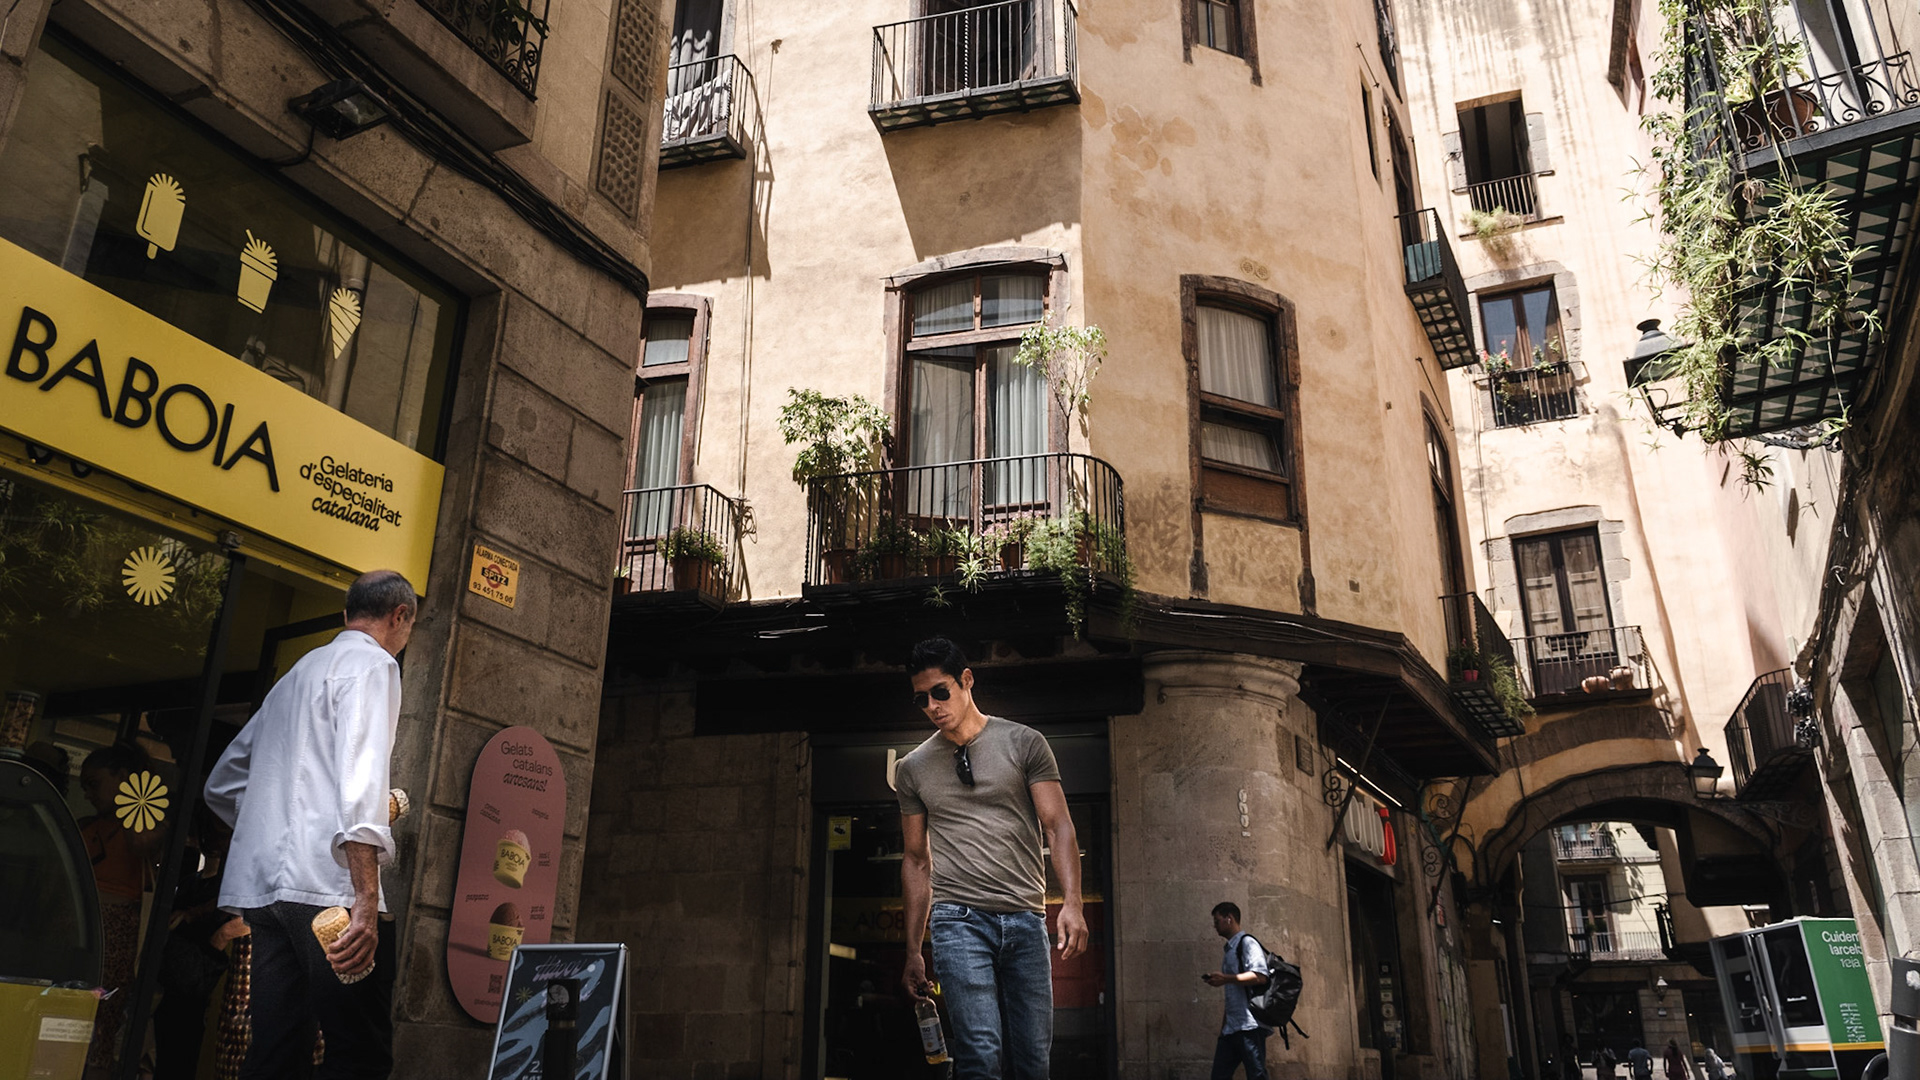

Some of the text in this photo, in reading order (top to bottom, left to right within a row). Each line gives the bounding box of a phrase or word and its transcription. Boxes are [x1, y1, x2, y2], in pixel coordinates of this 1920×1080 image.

[5, 306, 280, 493] BABOIA
[320, 455, 393, 492] Gelateria
[300, 462, 402, 527] d'especialitat
[312, 497, 380, 532] catalana
[476, 546, 518, 572] ALARMA CONECTADA
[473, 582, 481, 591] 93
[495, 590, 504, 600] 75
[501, 741, 534, 756] Gelats
[512, 759, 553, 777] catalans
